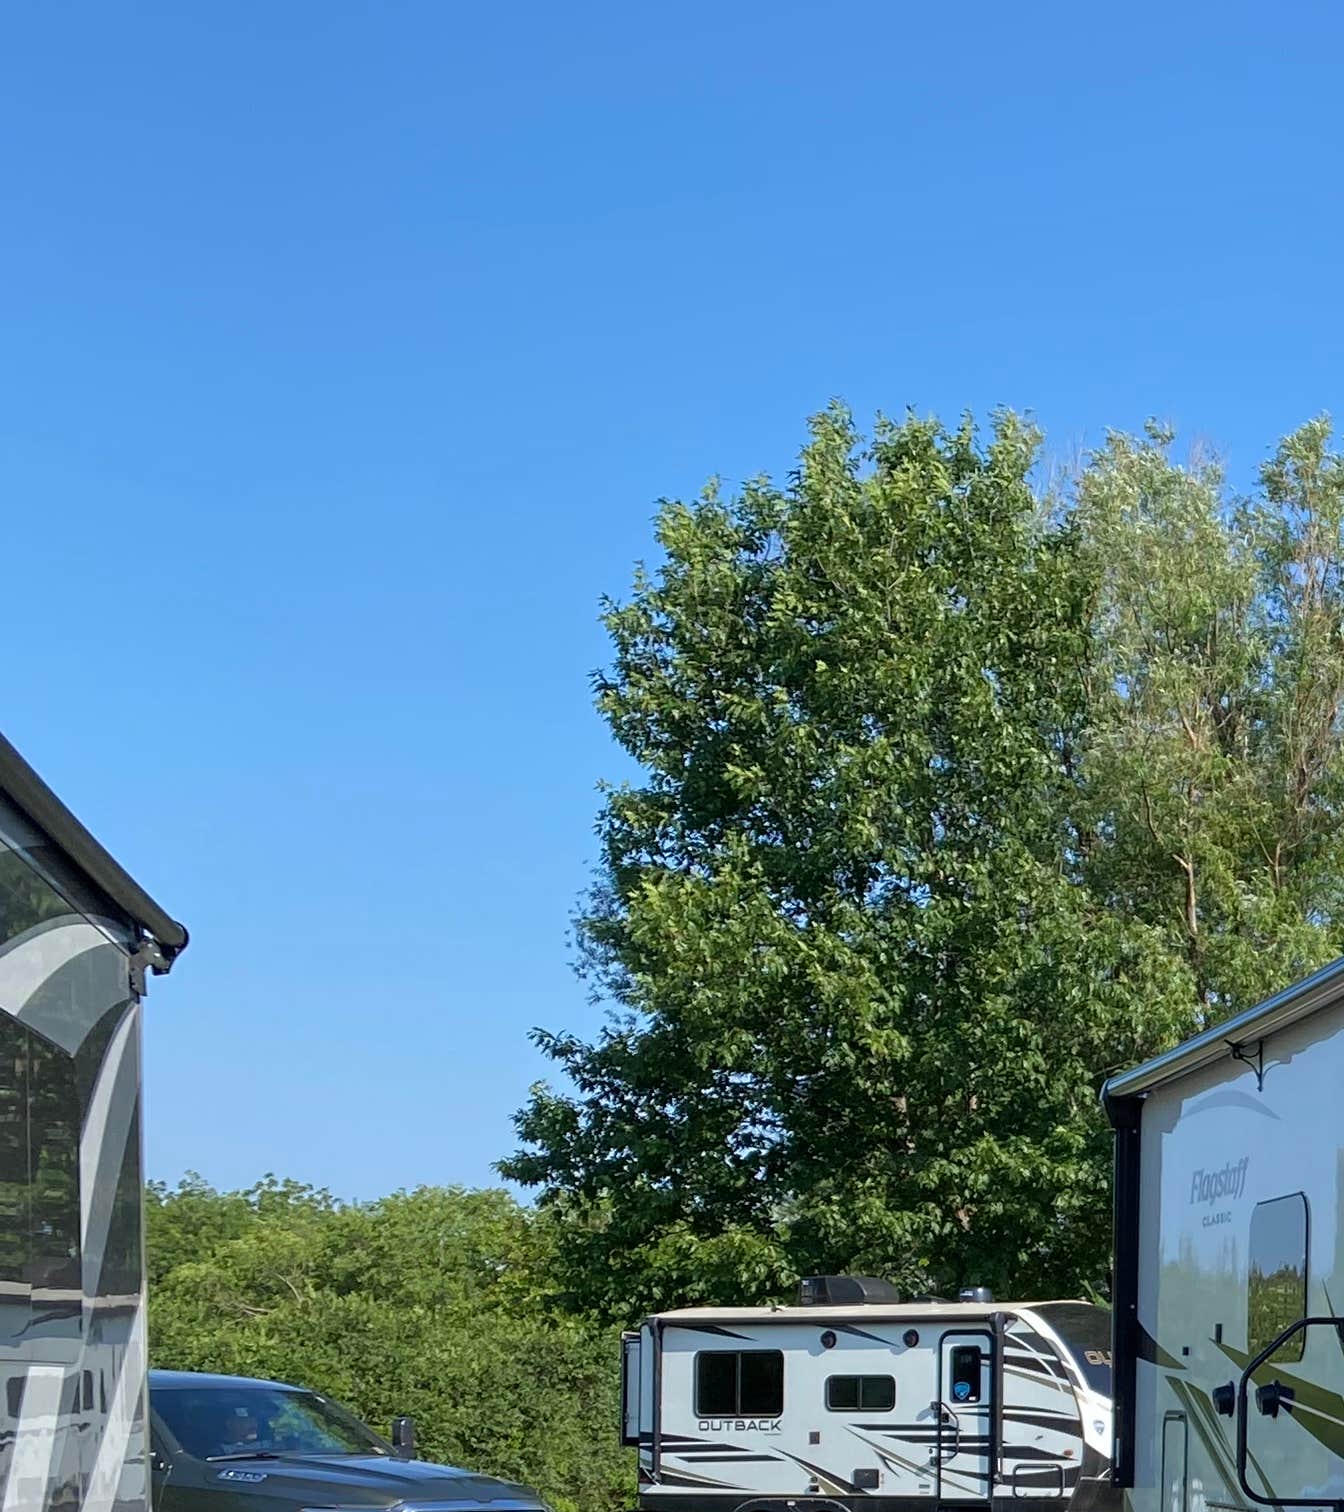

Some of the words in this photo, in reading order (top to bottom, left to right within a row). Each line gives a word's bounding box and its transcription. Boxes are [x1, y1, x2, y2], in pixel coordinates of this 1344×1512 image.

[1190, 1155, 1250, 1206] Flagstaff
[1202, 1211, 1232, 1228] CLASSIC
[697, 1418, 783, 1433] OUTBACK
